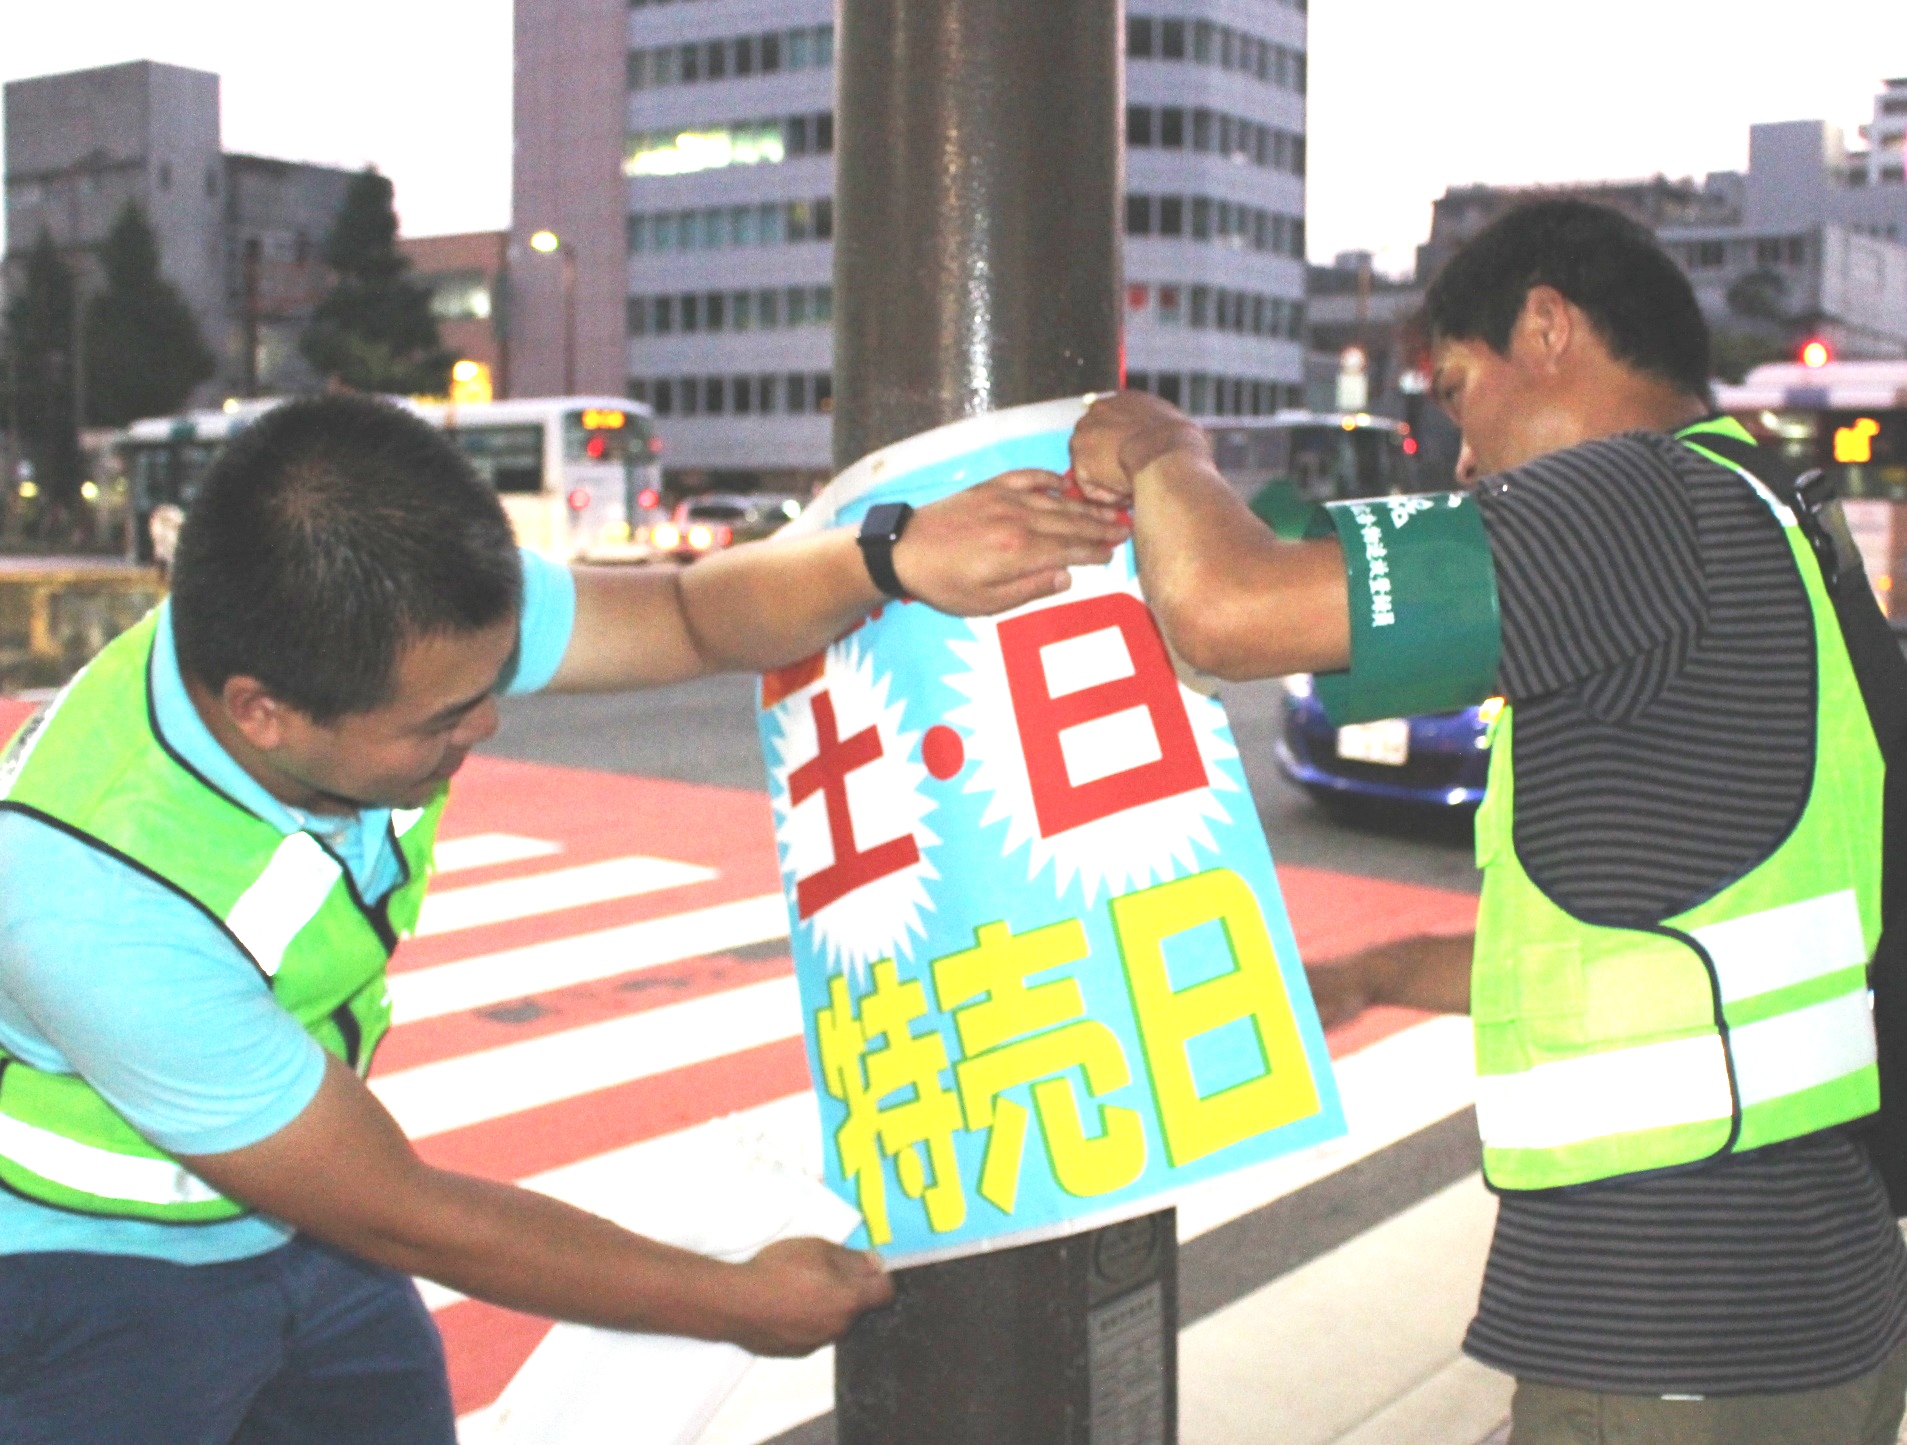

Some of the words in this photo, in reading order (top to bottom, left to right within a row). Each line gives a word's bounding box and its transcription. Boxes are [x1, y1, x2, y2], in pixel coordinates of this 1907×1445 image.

[788, 592, 1209, 921] 土・日
[815, 867, 1321, 1246] 特売日
